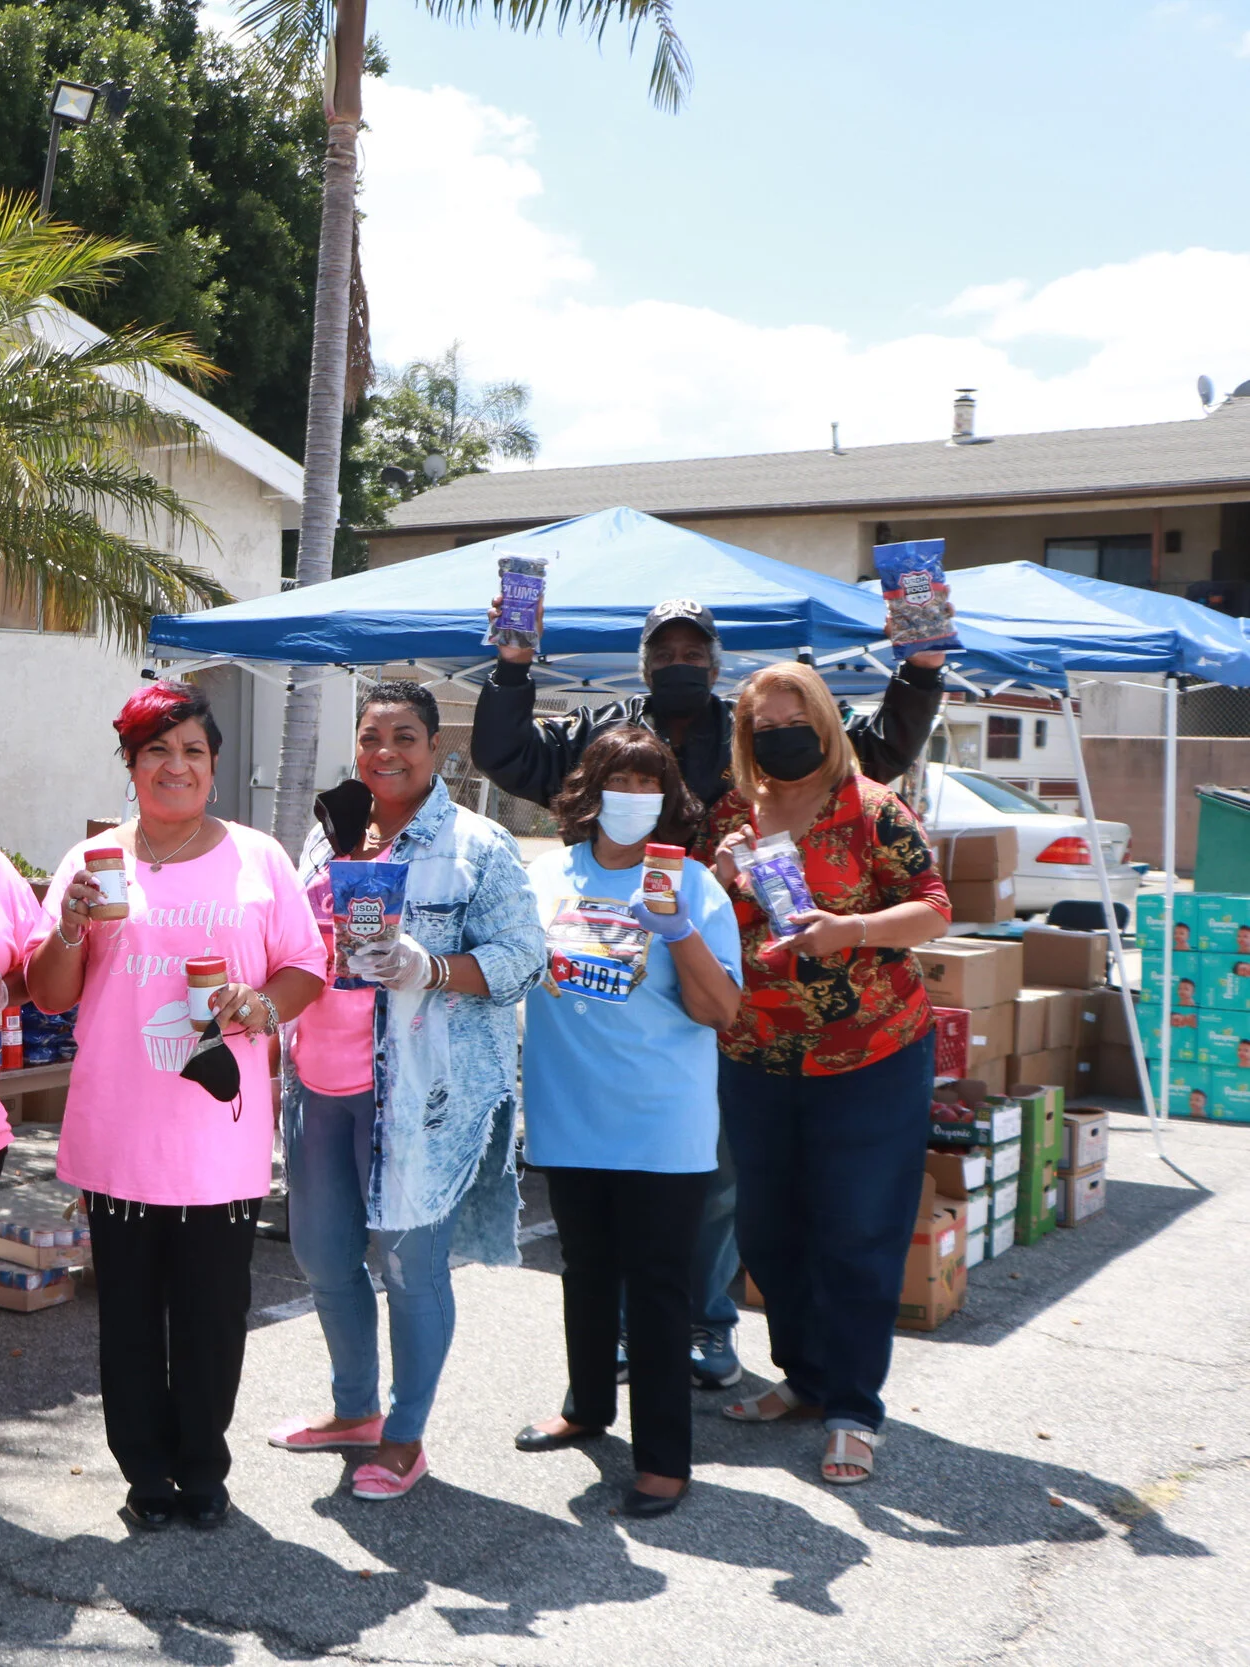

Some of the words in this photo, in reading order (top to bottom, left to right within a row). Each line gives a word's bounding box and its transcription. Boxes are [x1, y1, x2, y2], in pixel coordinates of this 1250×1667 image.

[904, 577, 927, 585] USDA
[502, 584, 539, 601] PLUMS
[906, 585, 930, 594] FOOD
[352, 904, 380, 913] USDA
[352, 915, 380, 923] FOOD
[568, 960, 621, 996] CUBA
[933, 1123, 972, 1141] Organic
